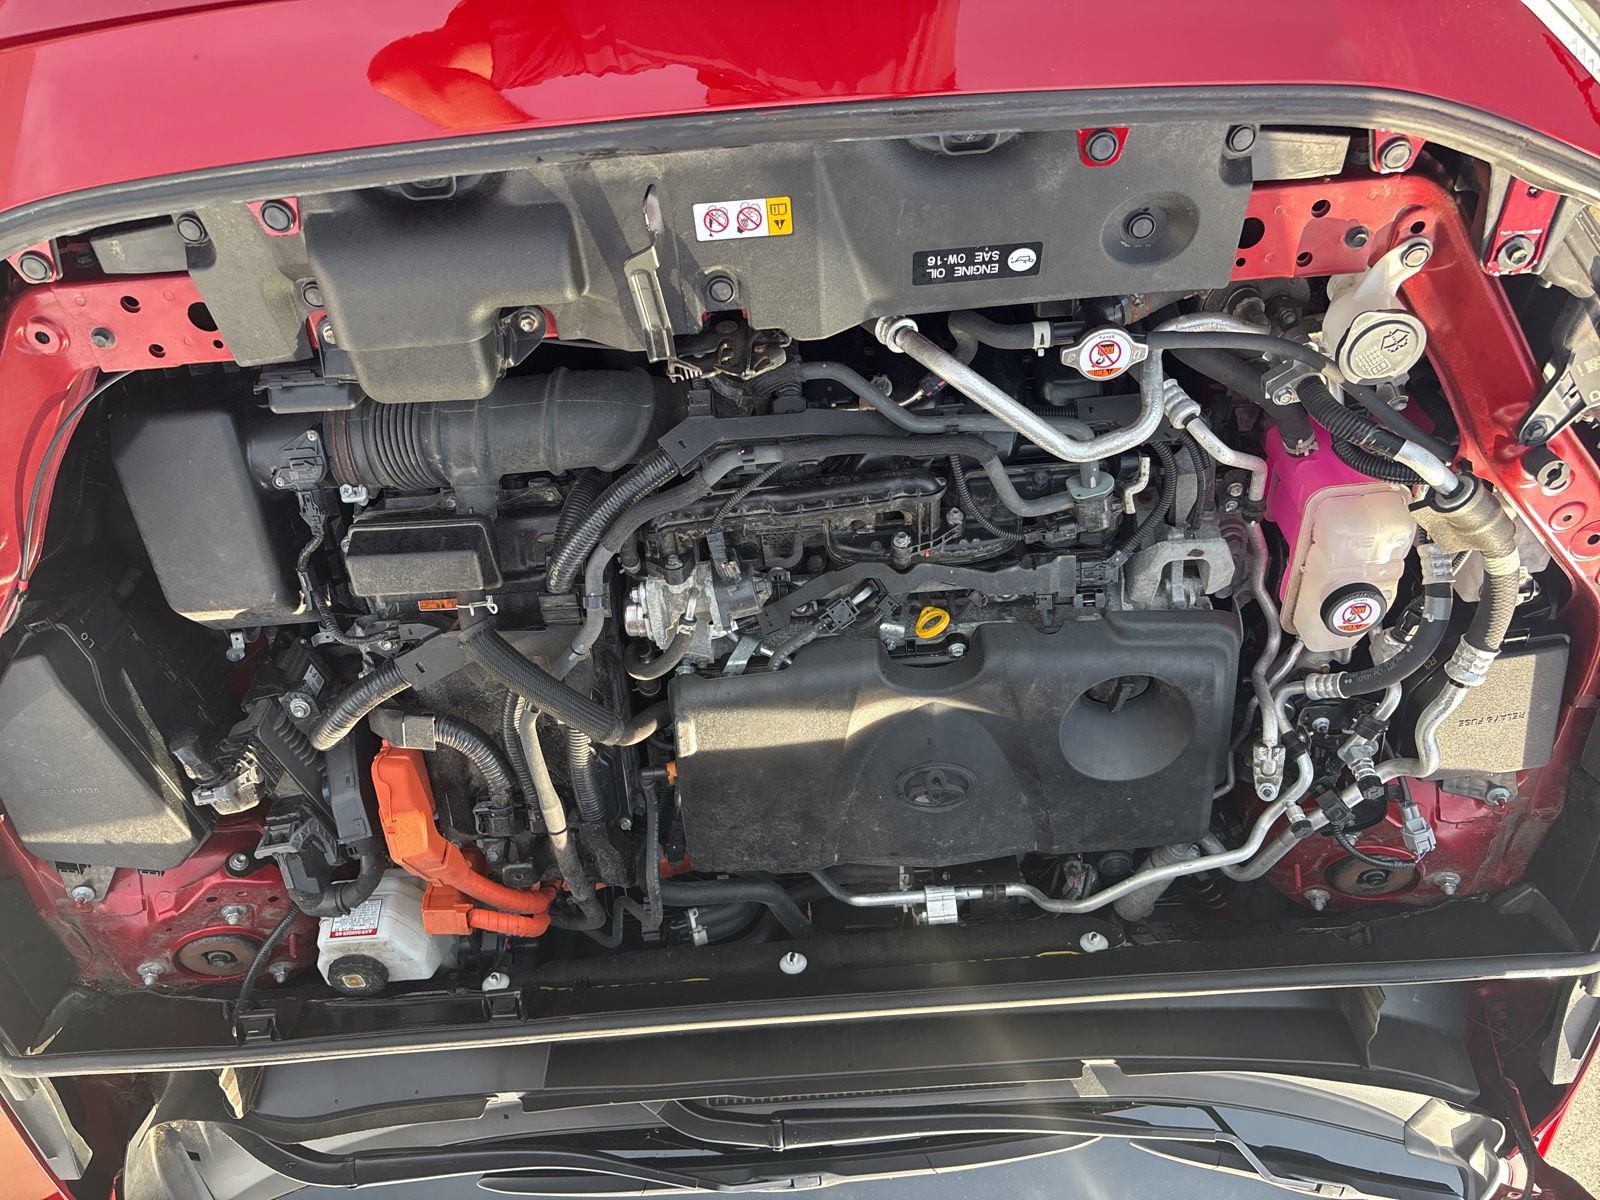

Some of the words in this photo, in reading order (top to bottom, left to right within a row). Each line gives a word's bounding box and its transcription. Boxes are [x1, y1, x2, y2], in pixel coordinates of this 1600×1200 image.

[927, 253, 966, 266] 0W-16
[974, 250, 1000, 262] SAE
[926, 268, 946, 278] OIL
[953, 263, 999, 276] ENGINE
[1458, 717, 1484, 727] FUSE
[1494, 711, 1525, 722] RELAY
[71, 786, 100, 794] RELAY
